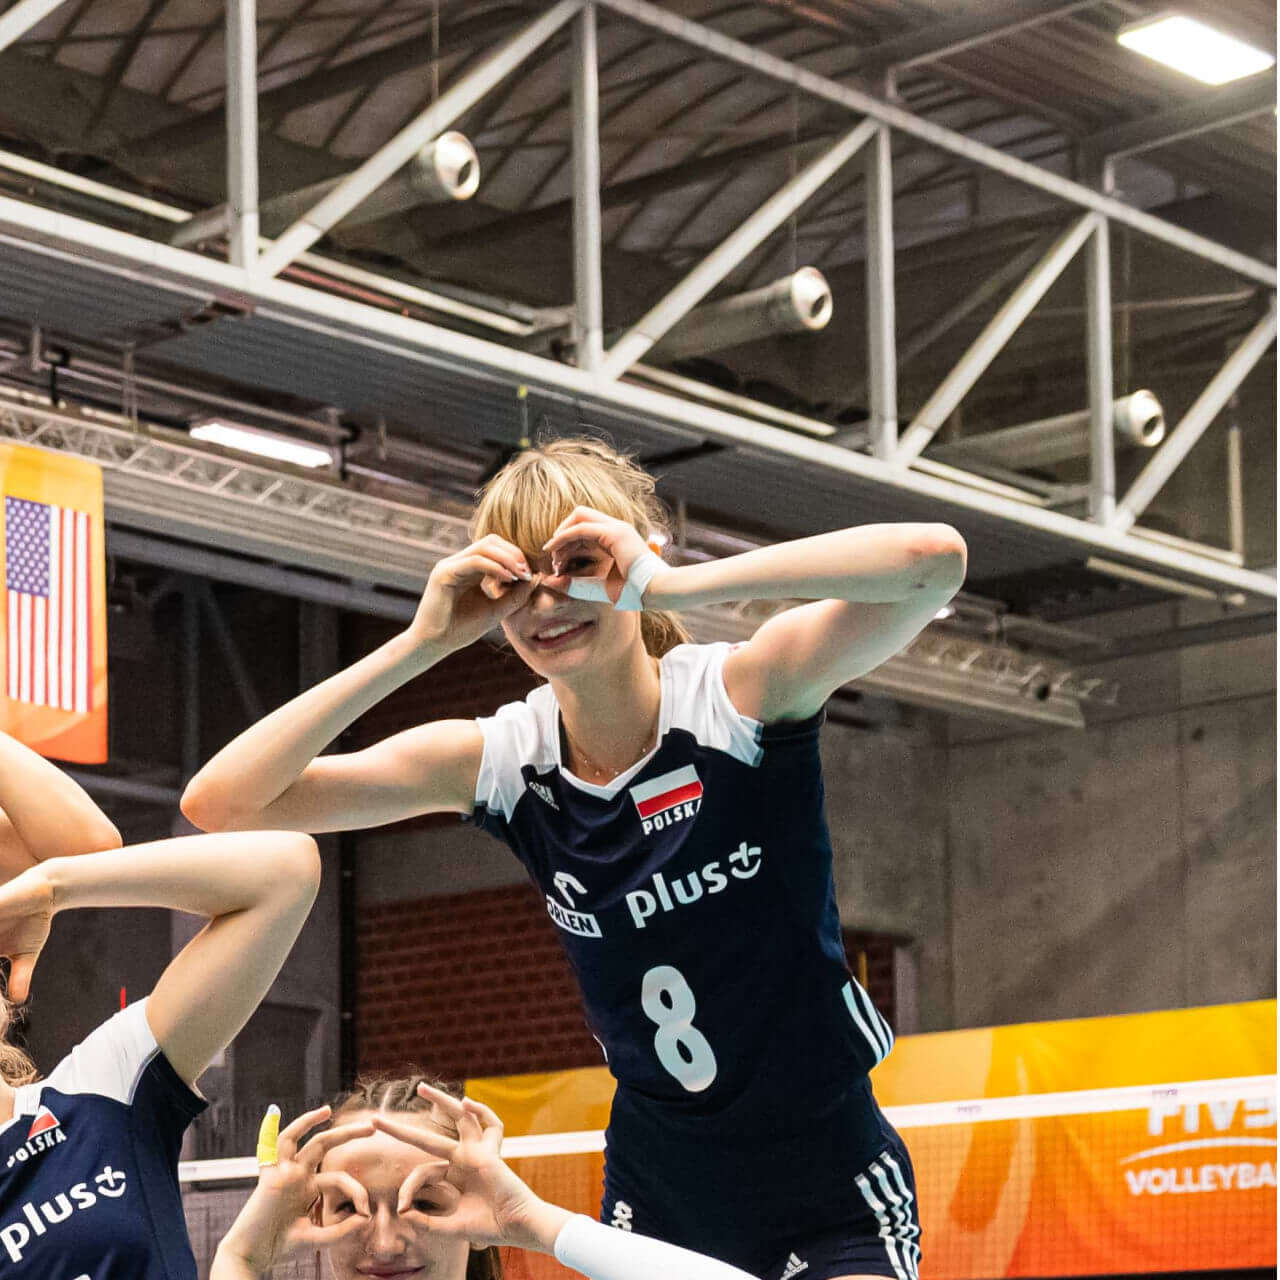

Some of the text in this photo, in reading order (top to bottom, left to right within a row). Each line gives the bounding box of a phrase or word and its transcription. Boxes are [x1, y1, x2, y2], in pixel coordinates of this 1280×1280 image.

[625, 861, 727, 929] plus
[641, 965, 718, 1093] 8
[0, 1182, 97, 1264] plus
